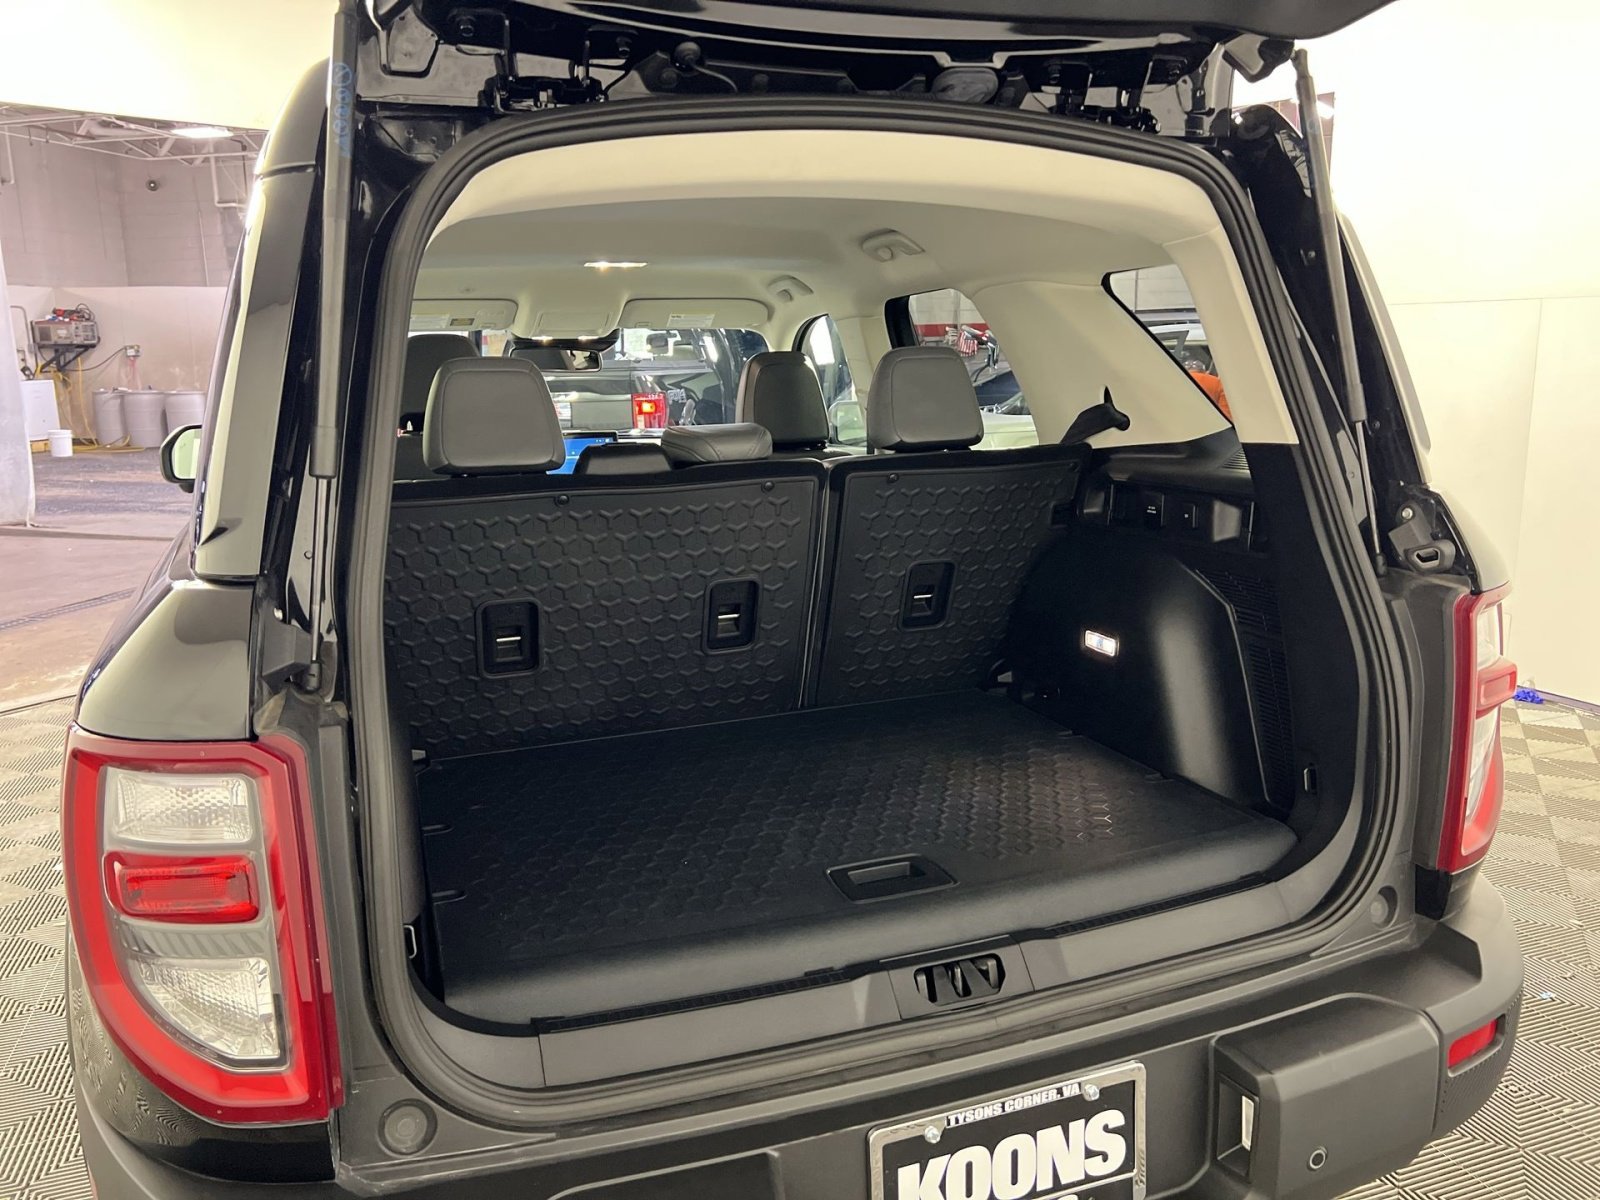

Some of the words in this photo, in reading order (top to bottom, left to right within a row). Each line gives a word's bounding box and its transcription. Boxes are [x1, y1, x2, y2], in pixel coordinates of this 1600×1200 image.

[948, 1103, 1003, 1126] TYSONS
[1062, 1082, 1080, 1096] VA
[897, 1109, 1127, 1200] KOONS
